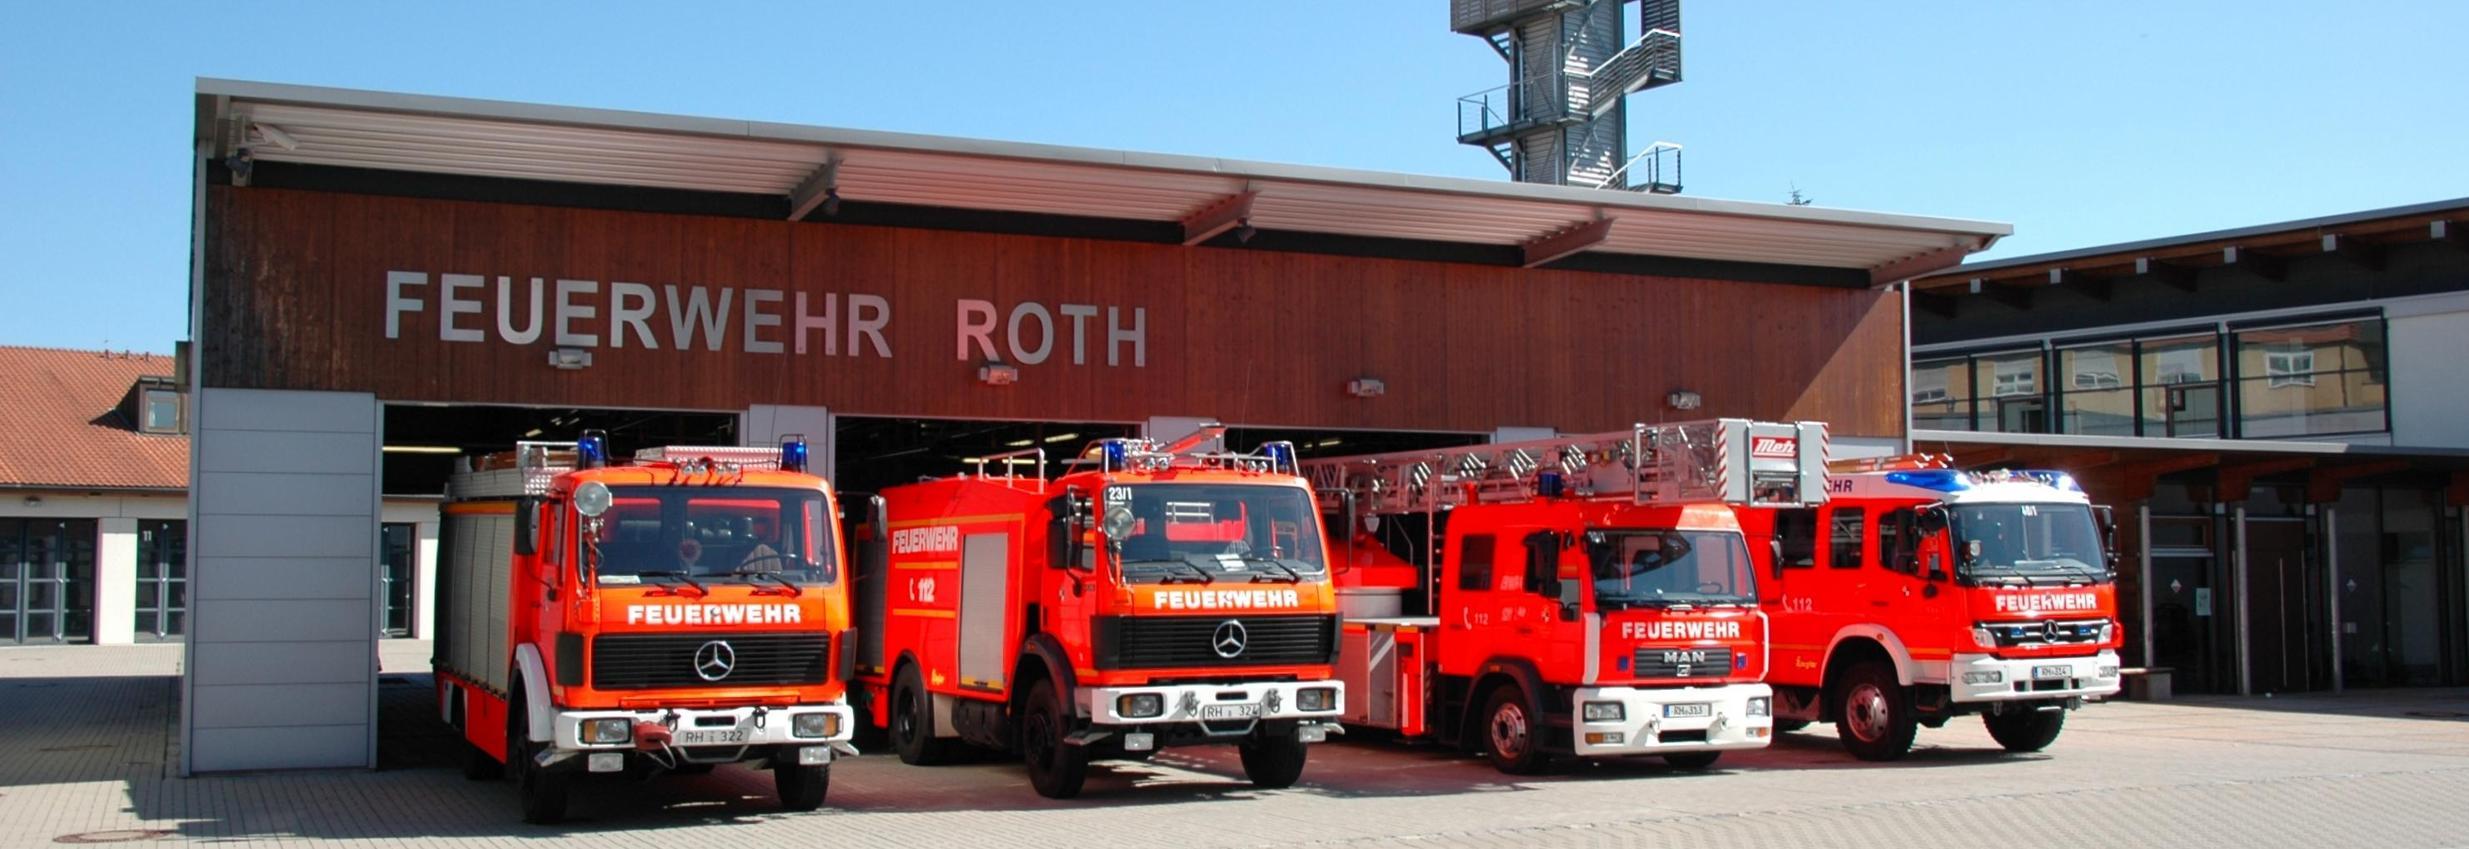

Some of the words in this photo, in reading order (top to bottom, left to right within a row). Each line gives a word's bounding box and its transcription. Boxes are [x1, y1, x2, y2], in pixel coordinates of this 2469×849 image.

[385, 270, 893, 358] FEUERWEHR
[957, 299, 1146, 368] ROTH
[1108, 486, 1132, 501] 23/1
[142, 530, 152, 542] 11
[892, 525, 959, 555] FEUERWEHR
[918, 577, 936, 603] 112
[1154, 589, 1299, 609] FEUERWEHR
[1792, 597, 1813, 612] 112
[1995, 592, 2097, 612] FEUERWEHR
[627, 603, 801, 625] FEUERWEHR
[1474, 612, 1488, 625] 112
[1621, 621, 1740, 640] FEUERWEHR
[1664, 651, 1705, 663] MAN
